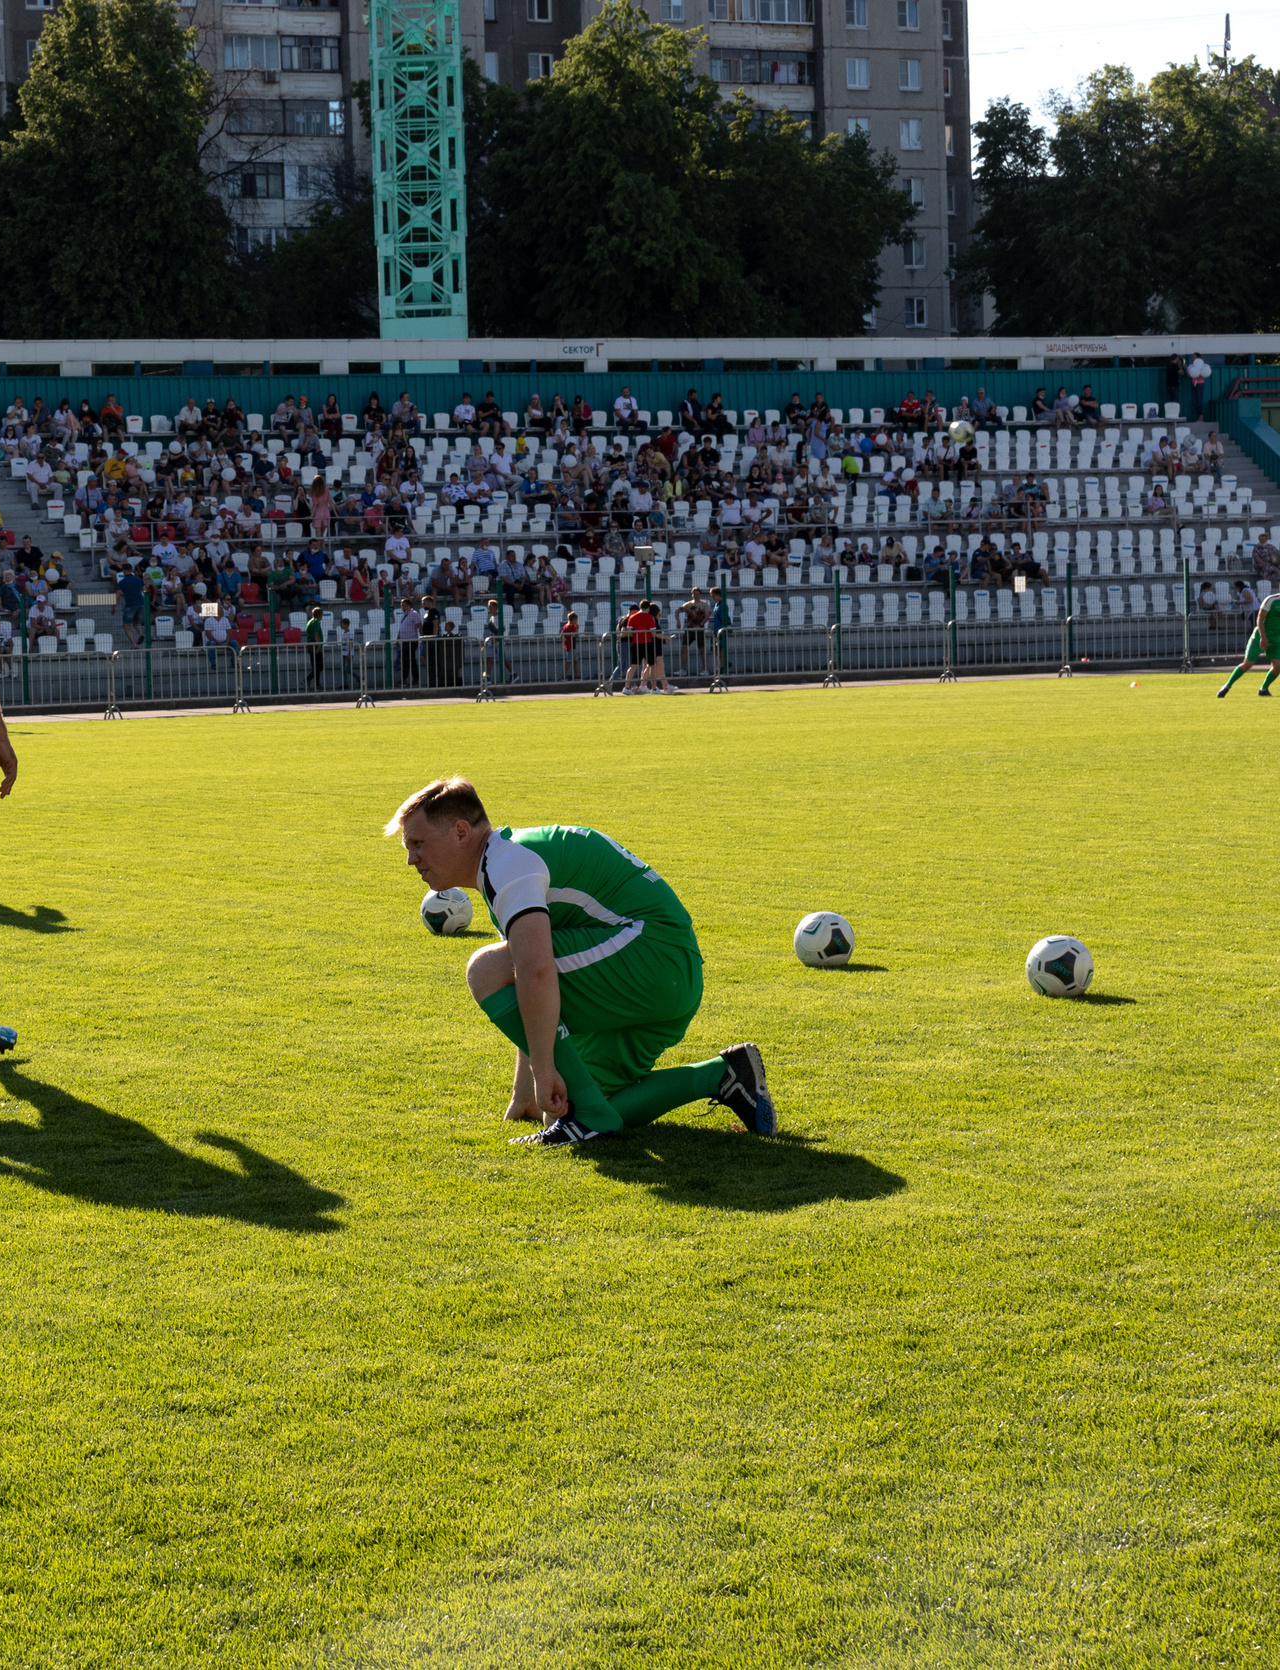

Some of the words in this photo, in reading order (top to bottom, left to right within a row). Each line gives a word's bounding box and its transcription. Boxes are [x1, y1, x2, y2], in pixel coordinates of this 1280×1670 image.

[562, 346, 595, 354] СЕКТОР
[596, 342, 604, 358] Г
[1045, 344, 1078, 353] ЗАПАДНАЯ
[1078, 343, 1108, 352] ТРИБУНА
[1052, 961, 1072, 977] JAKO
